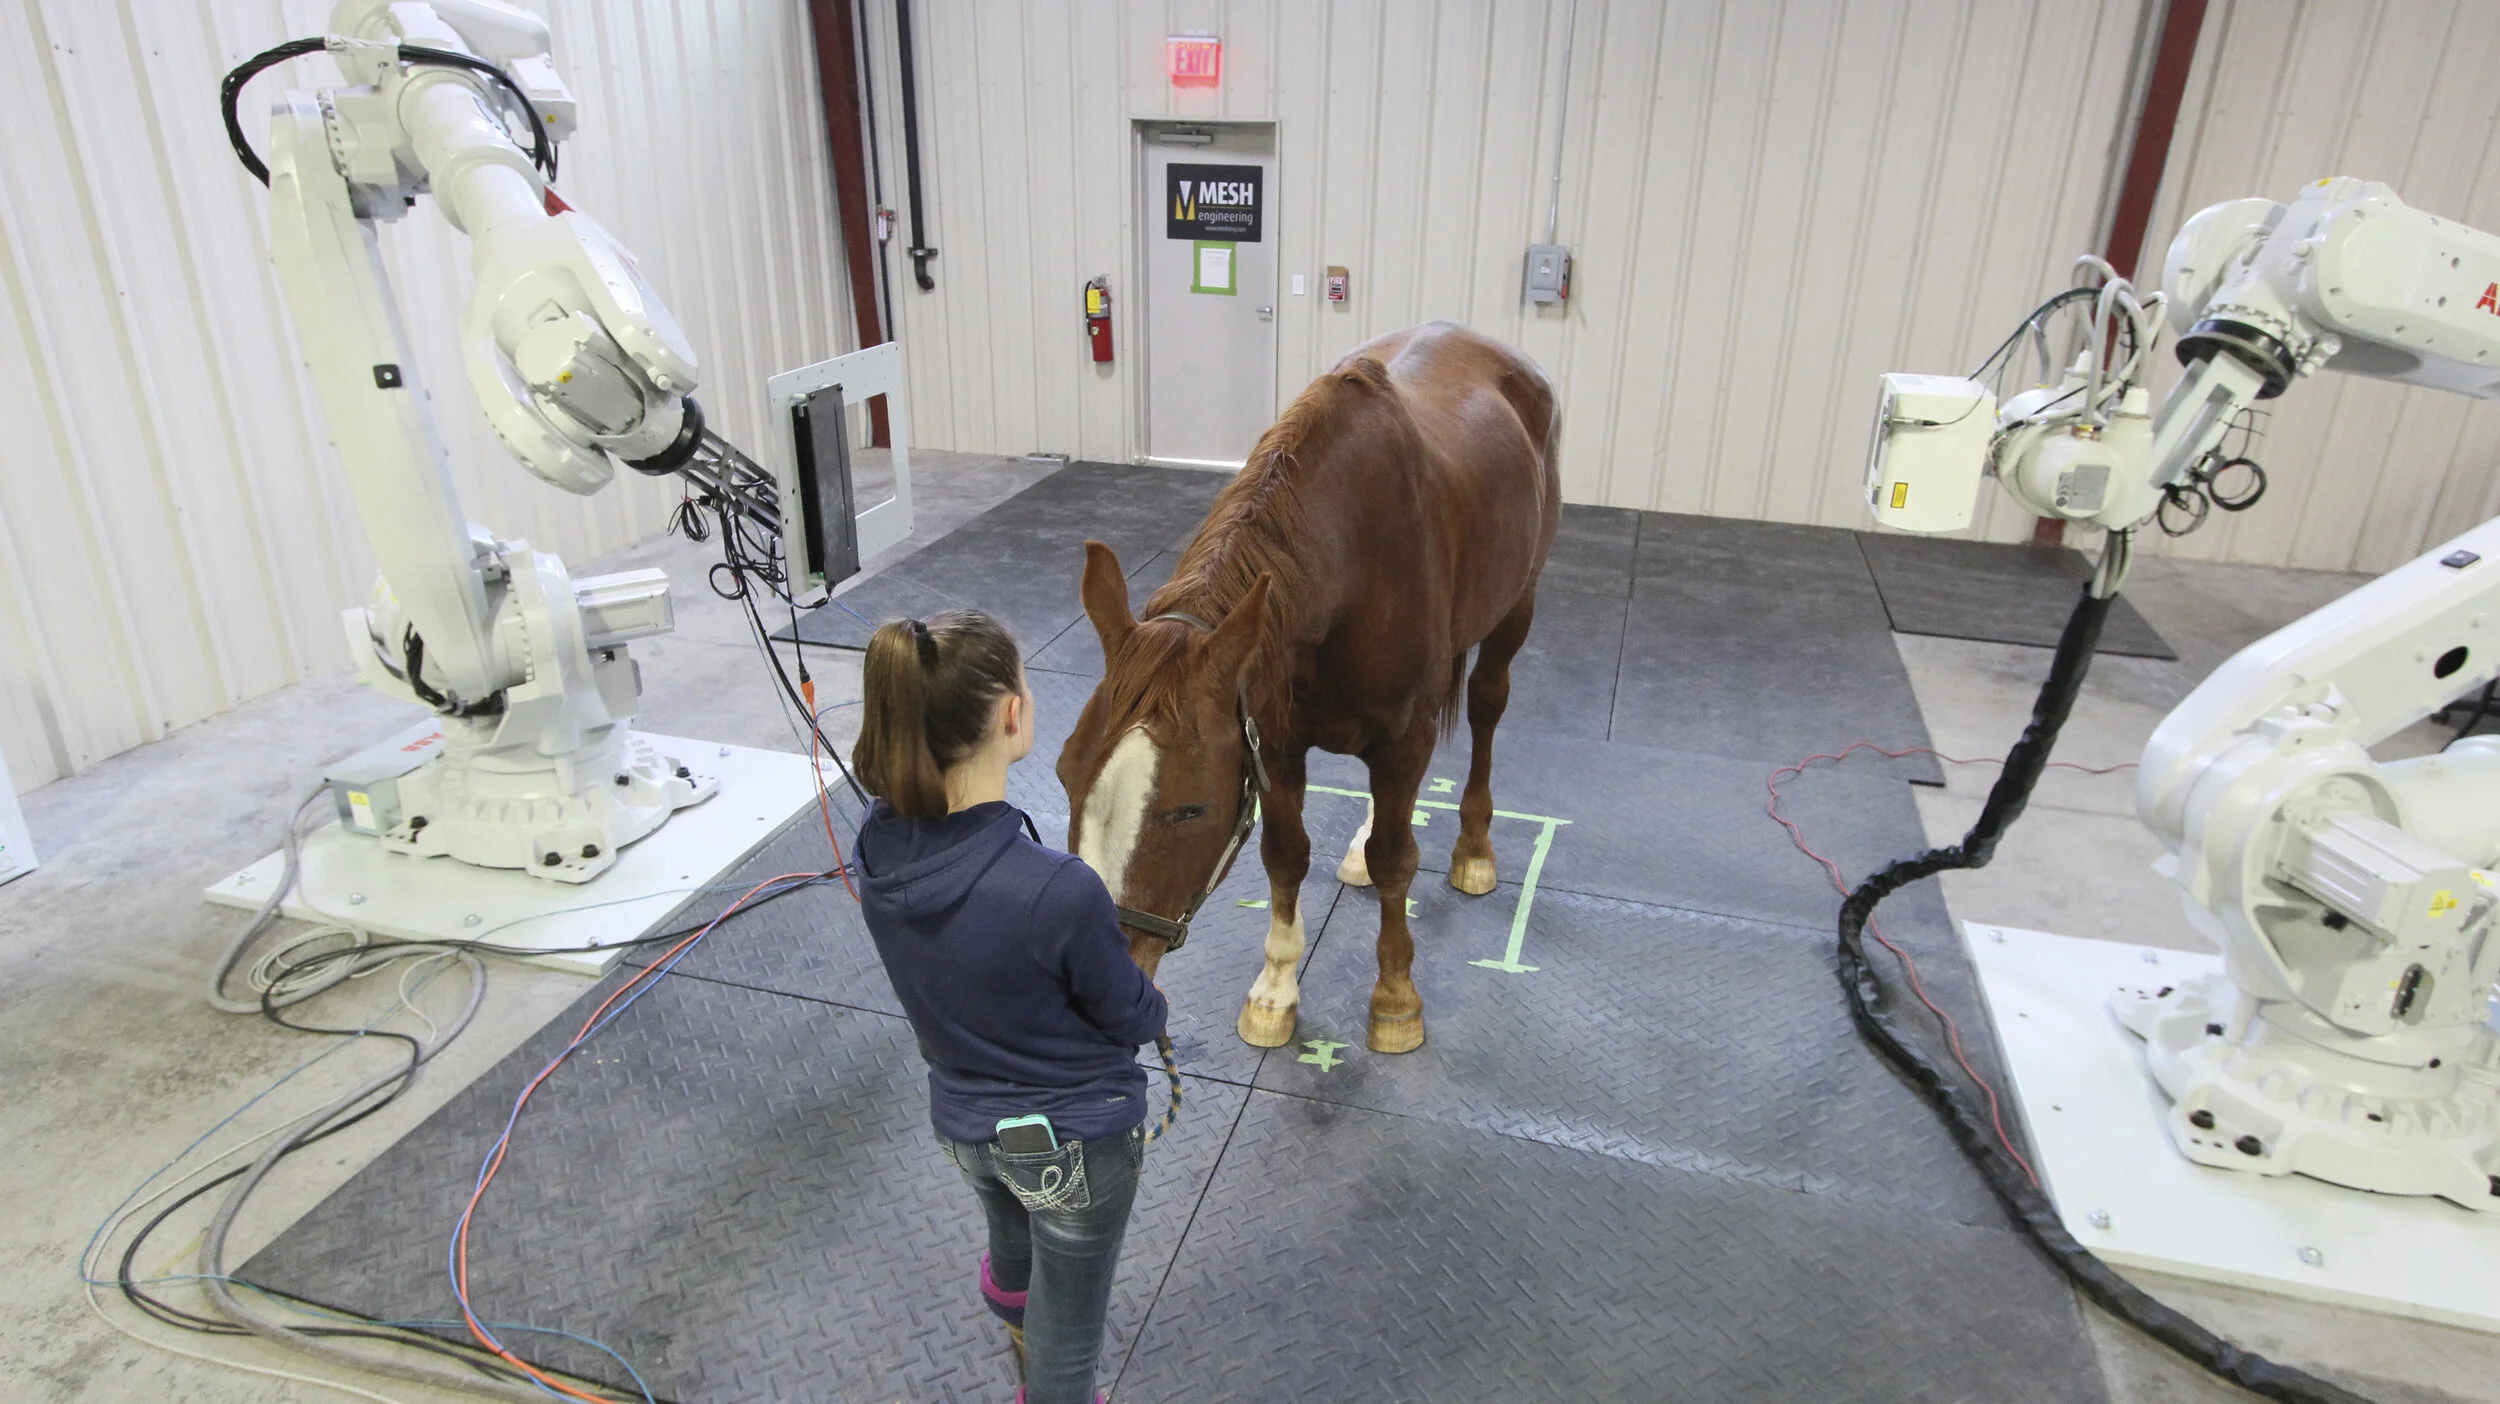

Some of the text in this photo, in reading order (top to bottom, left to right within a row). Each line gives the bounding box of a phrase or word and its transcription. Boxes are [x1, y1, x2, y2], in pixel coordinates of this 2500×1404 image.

[1175, 43, 1212, 74] EXIT
[1199, 181, 1253, 206] MESH
[1198, 211, 1253, 226] engineering
[2475, 282, 2500, 317] A
